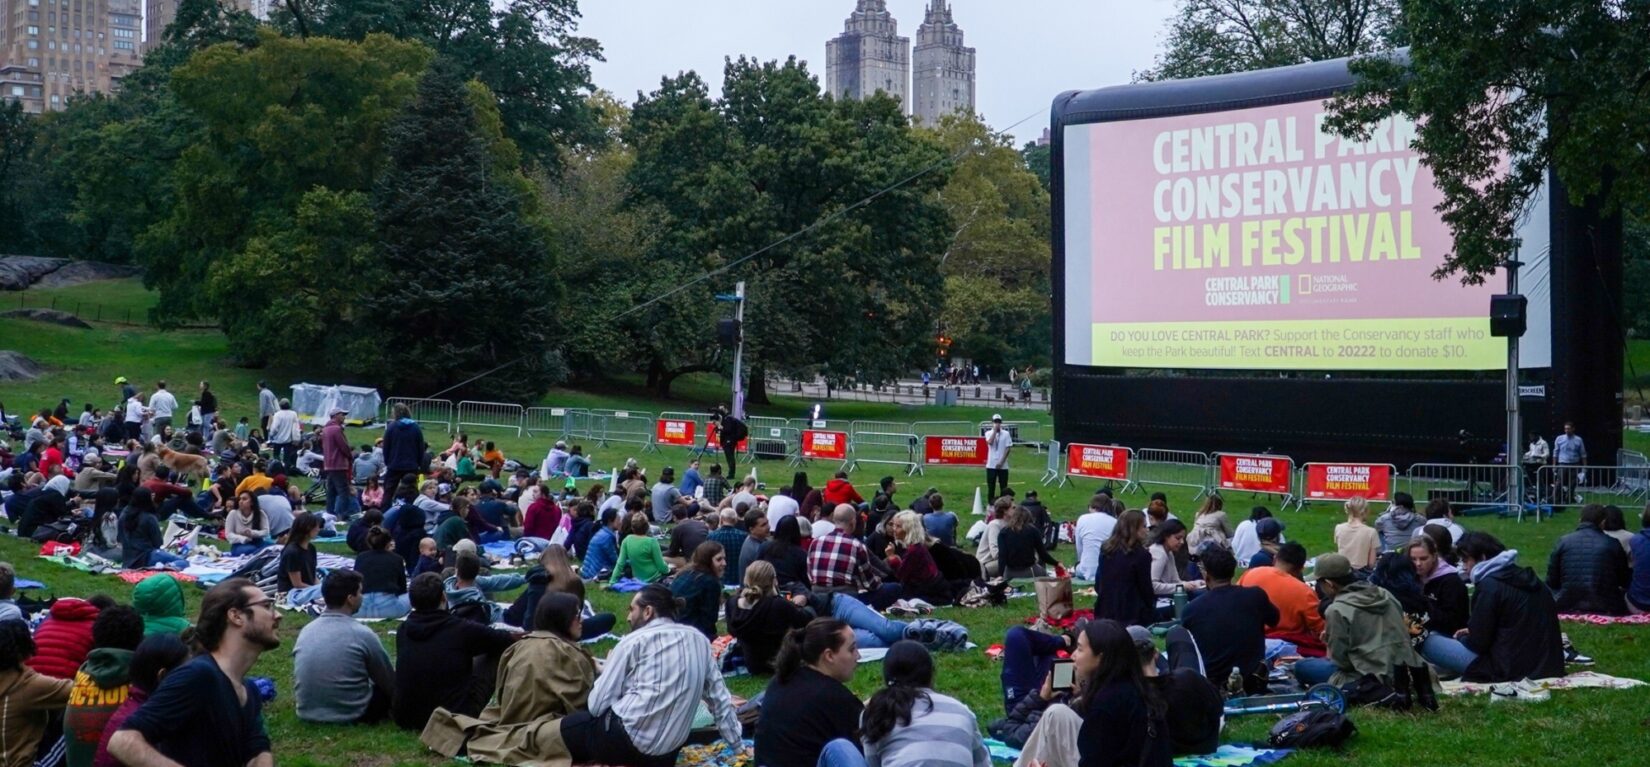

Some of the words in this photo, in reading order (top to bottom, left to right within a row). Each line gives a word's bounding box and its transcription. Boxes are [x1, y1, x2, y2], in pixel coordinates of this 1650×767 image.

[1153, 116, 1303, 175] CENTRAL
[1153, 156, 1420, 223] CONSERVANCY
[1154, 222, 1230, 271] FILM
[1242, 210, 1421, 267] FESTIVAL
[1205, 276, 1249, 292] CENTRAL
[1251, 275, 1280, 290] PARK
[1313, 274, 1348, 284] NATIONAL
[1312, 283, 1358, 293] GEOGRAPHIC
[1205, 290, 1279, 306] CONSERVANCY
[1110, 331, 1126, 342] DO
[1128, 331, 1149, 342] YOU
[1151, 330, 1179, 342] LOVE
[1181, 330, 1231, 342] CENTRAL
[1234, 329, 1270, 342] PARK?
[1274, 329, 1318, 345] Support
[1321, 329, 1340, 341] the
[1343, 328, 1421, 343] Conservancy
[1424, 327, 1452, 340] staff
[1456, 328, 1484, 340] who
[1122, 345, 1145, 358] keep
[1146, 345, 1163, 357] the
[1165, 345, 1186, 357] Park
[1189, 345, 1236, 357] beautiful!
[1240, 345, 1261, 357] Text
[1264, 345, 1319, 357] CENTRAL
[1323, 347, 1334, 357] to
[1338, 345, 1376, 358] 20222
[1379, 347, 1392, 357] to
[1395, 345, 1439, 358] donate
[1442, 344, 1468, 359] $10.
[1236, 458, 1258, 467] CENTRAL
[1258, 459, 1272, 468] PARK
[1236, 466, 1272, 475] CONSERVANCY
[1326, 466, 1352, 474] CENTRAL
[1353, 466, 1370, 474] PARK
[1235, 473, 1247, 481] FILM
[1248, 474, 1272, 483] FESTIVAL
[1326, 474, 1370, 482] CONSERVANCY
[1326, 482, 1340, 490] FILM
[1341, 482, 1370, 490] FESTIVAL
